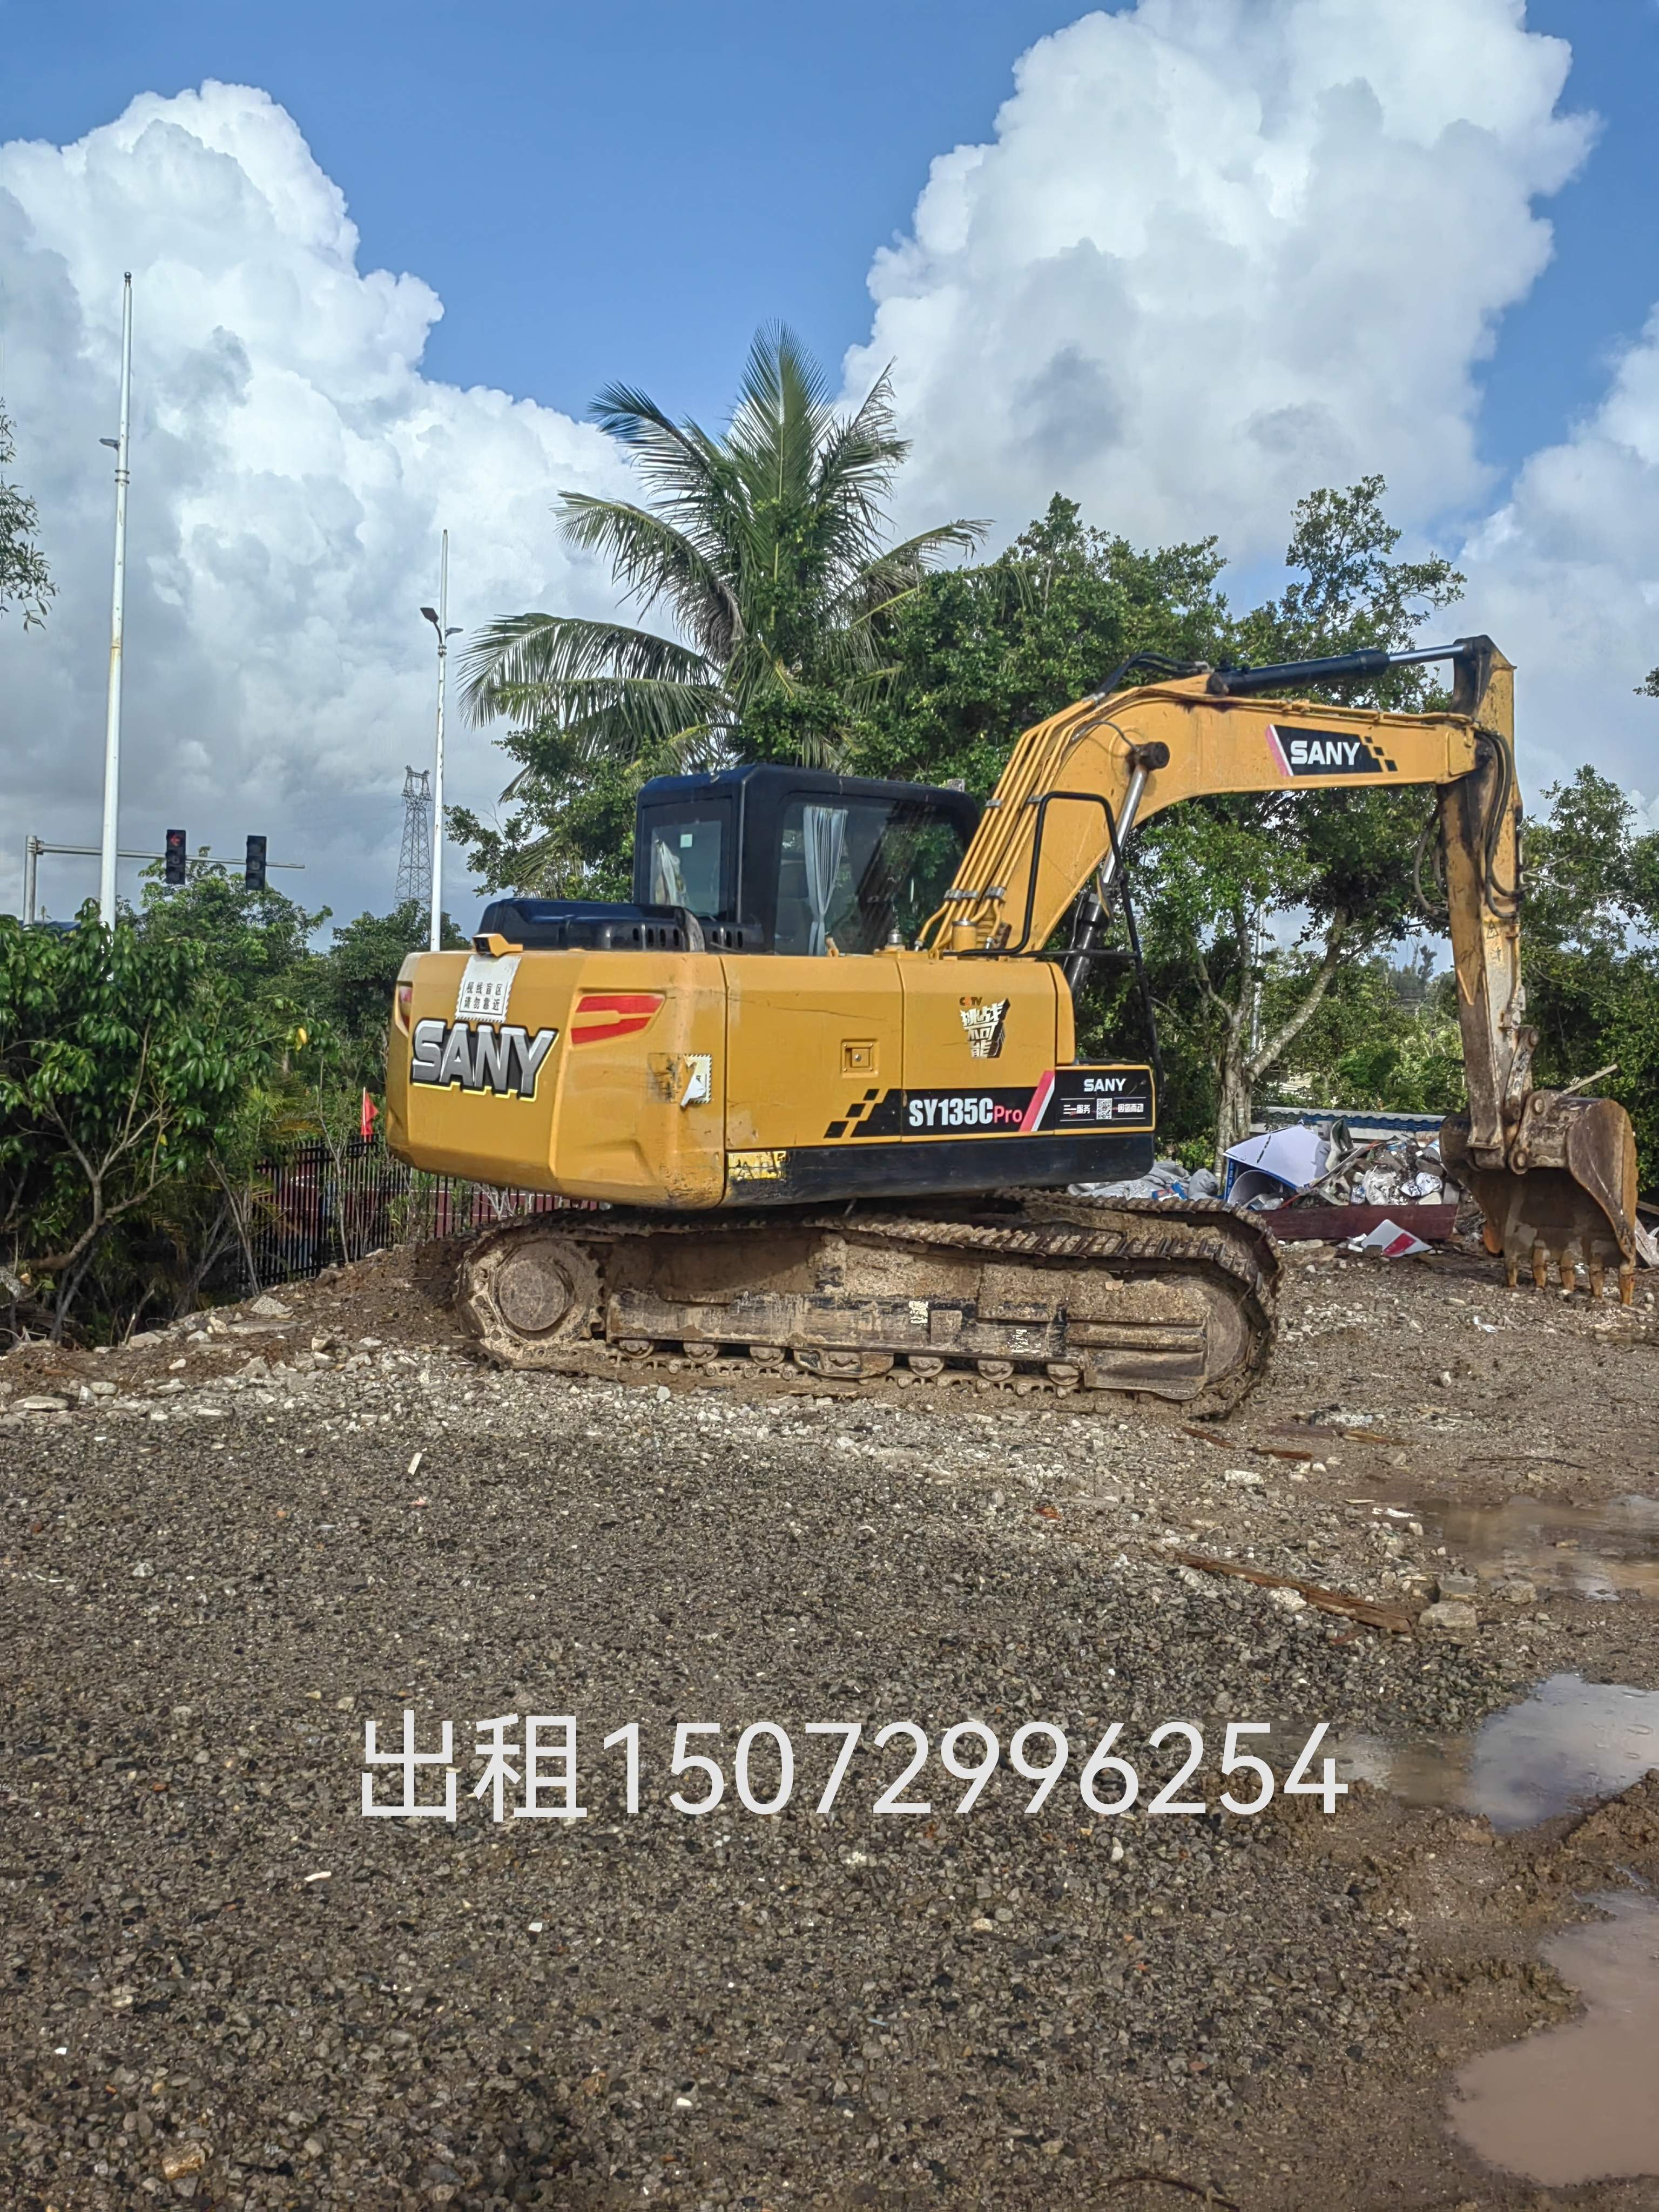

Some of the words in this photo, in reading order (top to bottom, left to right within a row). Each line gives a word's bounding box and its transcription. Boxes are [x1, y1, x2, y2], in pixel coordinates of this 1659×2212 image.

[1290, 740, 1361, 765] SANY
[464, 996, 501, 1011] 请勿靠近
[412, 1019, 559, 1100] SANY
[1084, 1078, 1126, 1092] SANY
